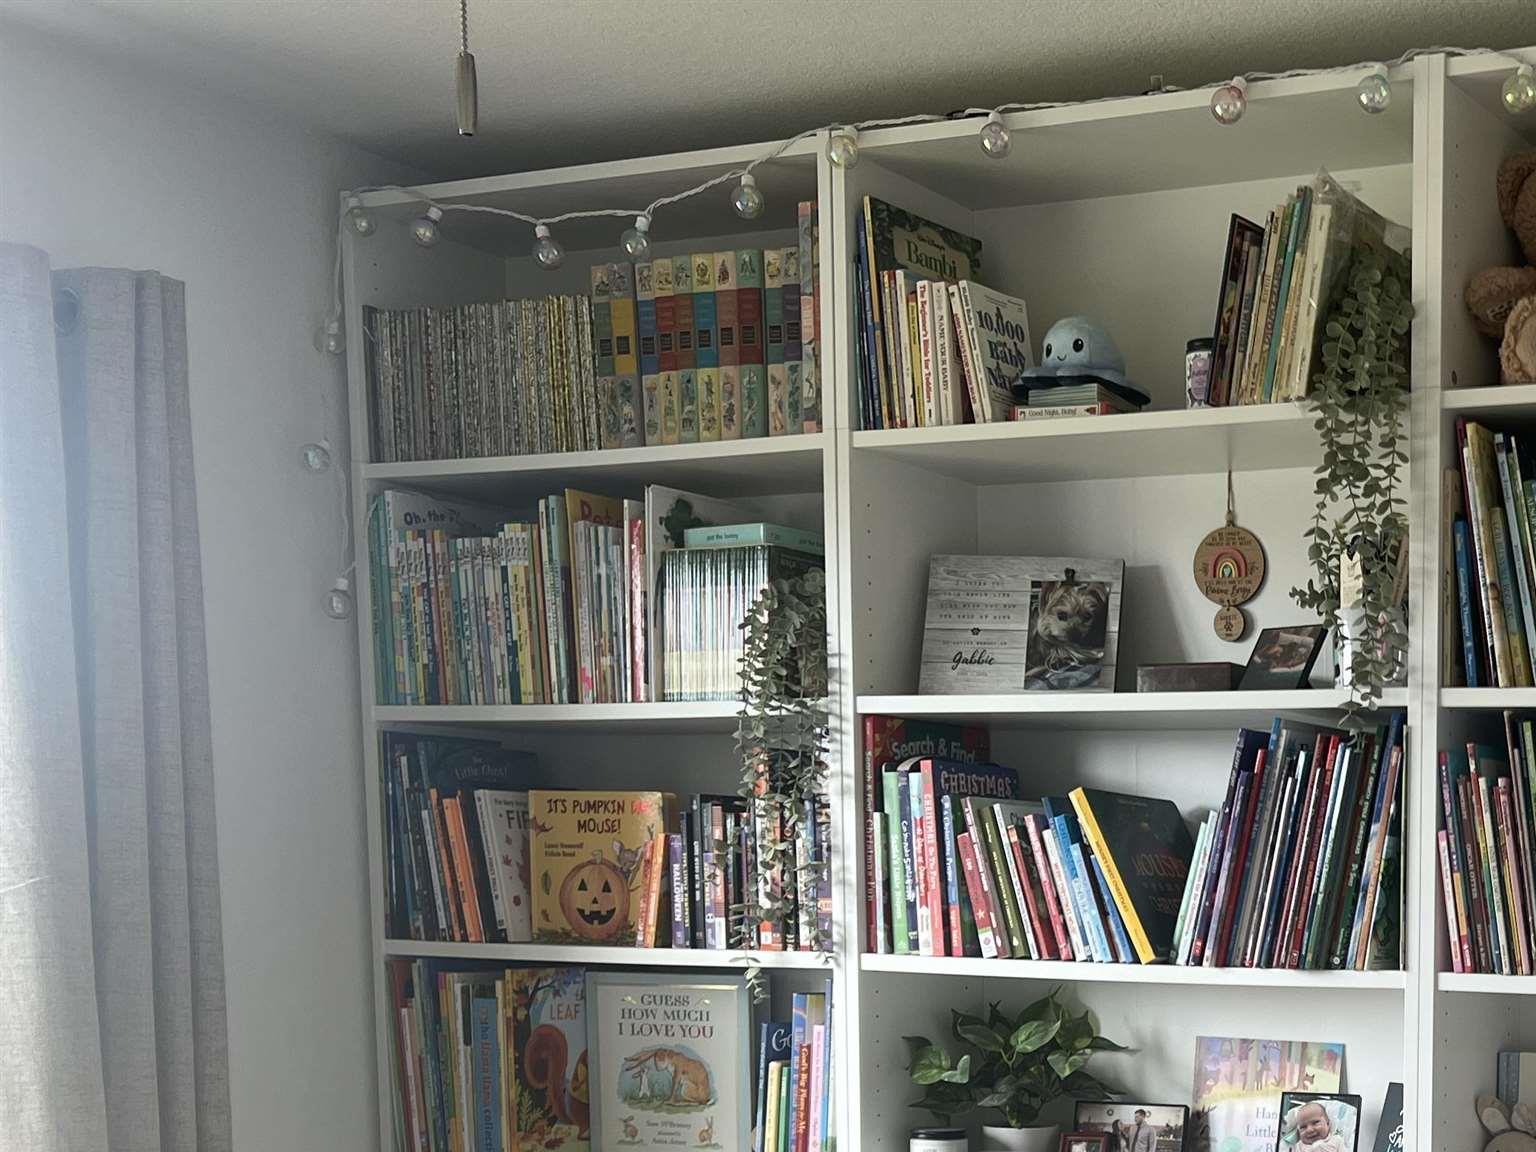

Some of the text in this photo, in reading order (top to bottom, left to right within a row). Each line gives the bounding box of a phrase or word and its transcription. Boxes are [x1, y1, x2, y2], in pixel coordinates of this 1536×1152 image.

[905, 238, 959, 282] Bambi
[919, 285, 927, 298] The
[920, 300, 930, 337] Beginner's
[976, 306, 1025, 344] 10,000
[922, 339, 931, 358] Bible
[937, 315, 949, 391] NAME YOUR BABY
[924, 371, 933, 403] Toddlers
[891, 736, 934, 760] Search
[950, 741, 976, 764] Find
[940, 768, 1013, 798] CHRISTMAS
[547, 798, 626, 815] IT'S PUMPKIN
[576, 818, 621, 834] MOUSE!
[865, 751, 876, 902] Search Find Christmas Fun
[1466, 843, 1478, 900] OSCAR OTTER
[673, 863, 683, 922] HALLOWEEN
[550, 1003, 581, 1021] LEAF
[640, 993, 691, 1007] GUESS
[619, 1007, 711, 1023] HOW MUCH
[617, 1023, 714, 1039] I LOVE YOU
